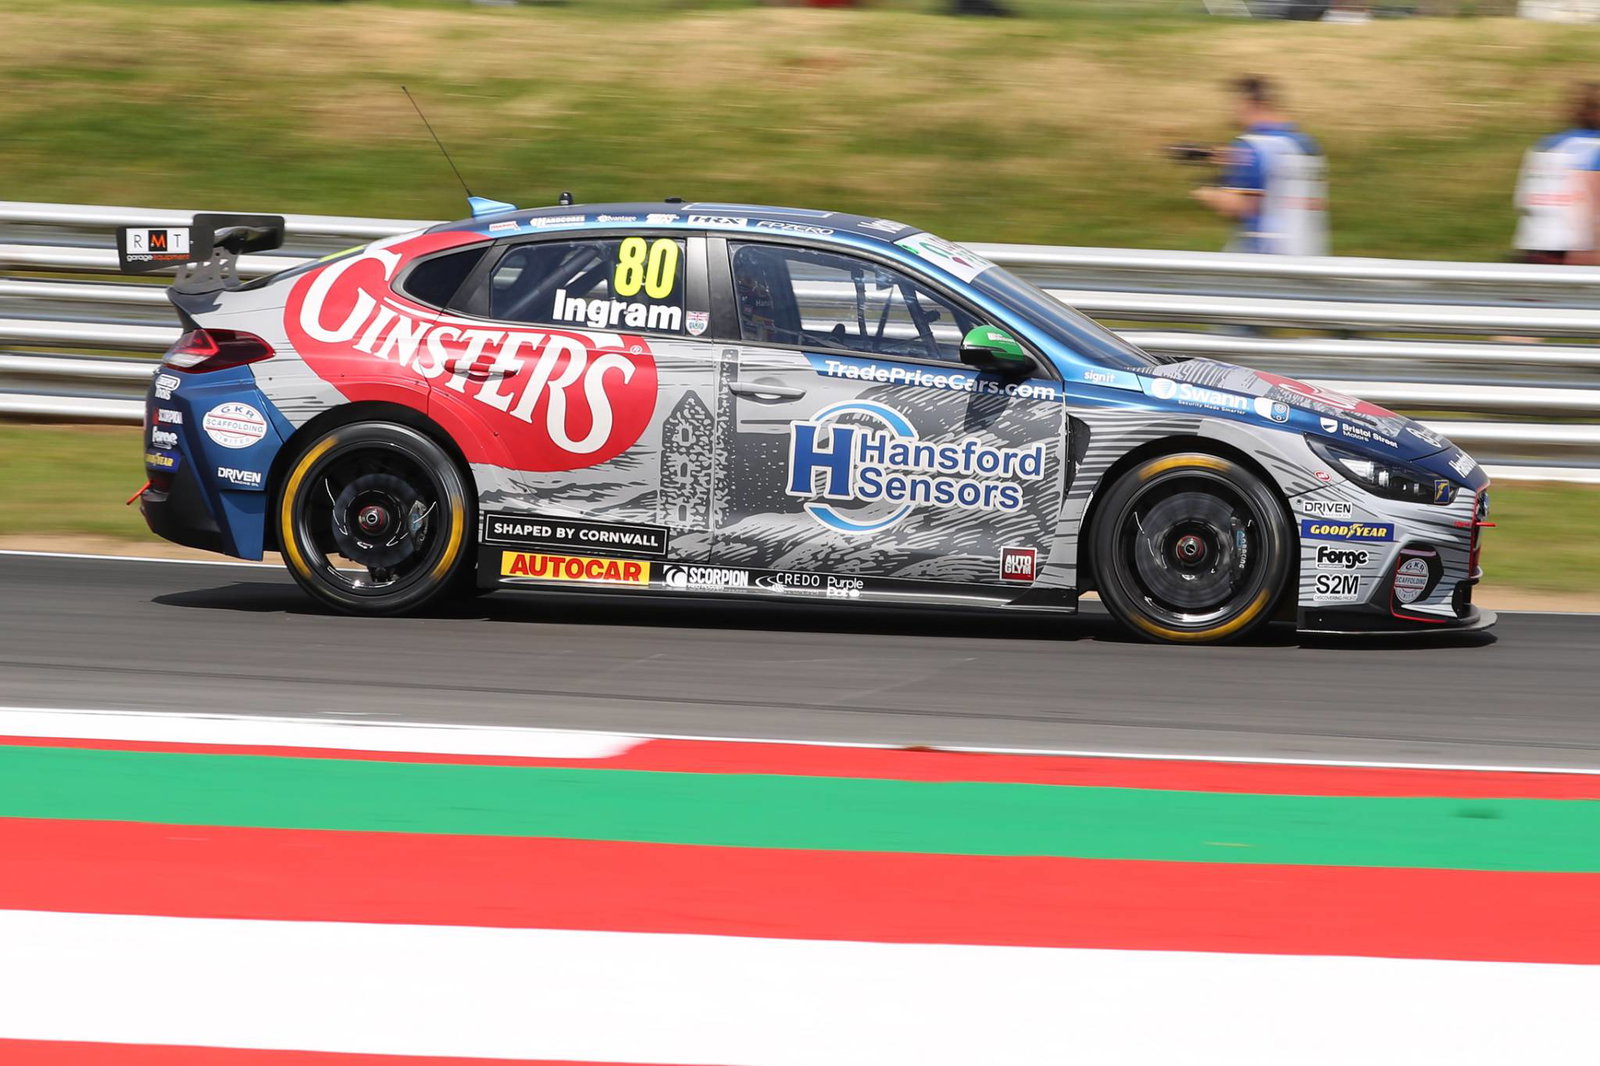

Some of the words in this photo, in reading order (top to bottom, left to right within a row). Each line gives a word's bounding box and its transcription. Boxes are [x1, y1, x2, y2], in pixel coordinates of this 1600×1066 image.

[614, 236, 679, 299] 80
[552, 288, 683, 331] Ingram
[299, 248, 636, 454] GINSTERS
[824, 359, 1056, 401] TradePriceCars.com
[1083, 370, 1116, 384] signit
[1180, 383, 1249, 410] Swann
[220, 405, 255, 418] GKR
[205, 417, 264, 433] SCAFFOLDING
[1342, 423, 1371, 438] Bristol
[1372, 432, 1399, 449] Street
[1342, 430, 1369, 442] Motors
[860, 432, 1044, 476] Hansford
[217, 466, 261, 484] DRIVEN
[858, 466, 1020, 510] Sensors
[1304, 502, 1351, 516] DRIVEN
[494, 522, 552, 538] SHAPED
[556, 527, 575, 539] BY
[579, 529, 659, 547] CORNWALL
[1310, 523, 1387, 539] GOODYEAR
[509, 553, 642, 582] AUTOCAR
[1005, 554, 1032, 566] AUTO
[1405, 561, 1425, 572] GKR
[688, 566, 749, 588] SCORPION
[776, 572, 820, 587] CREDO
[827, 576, 864, 590] Purple
[1316, 574, 1360, 595] S2M
